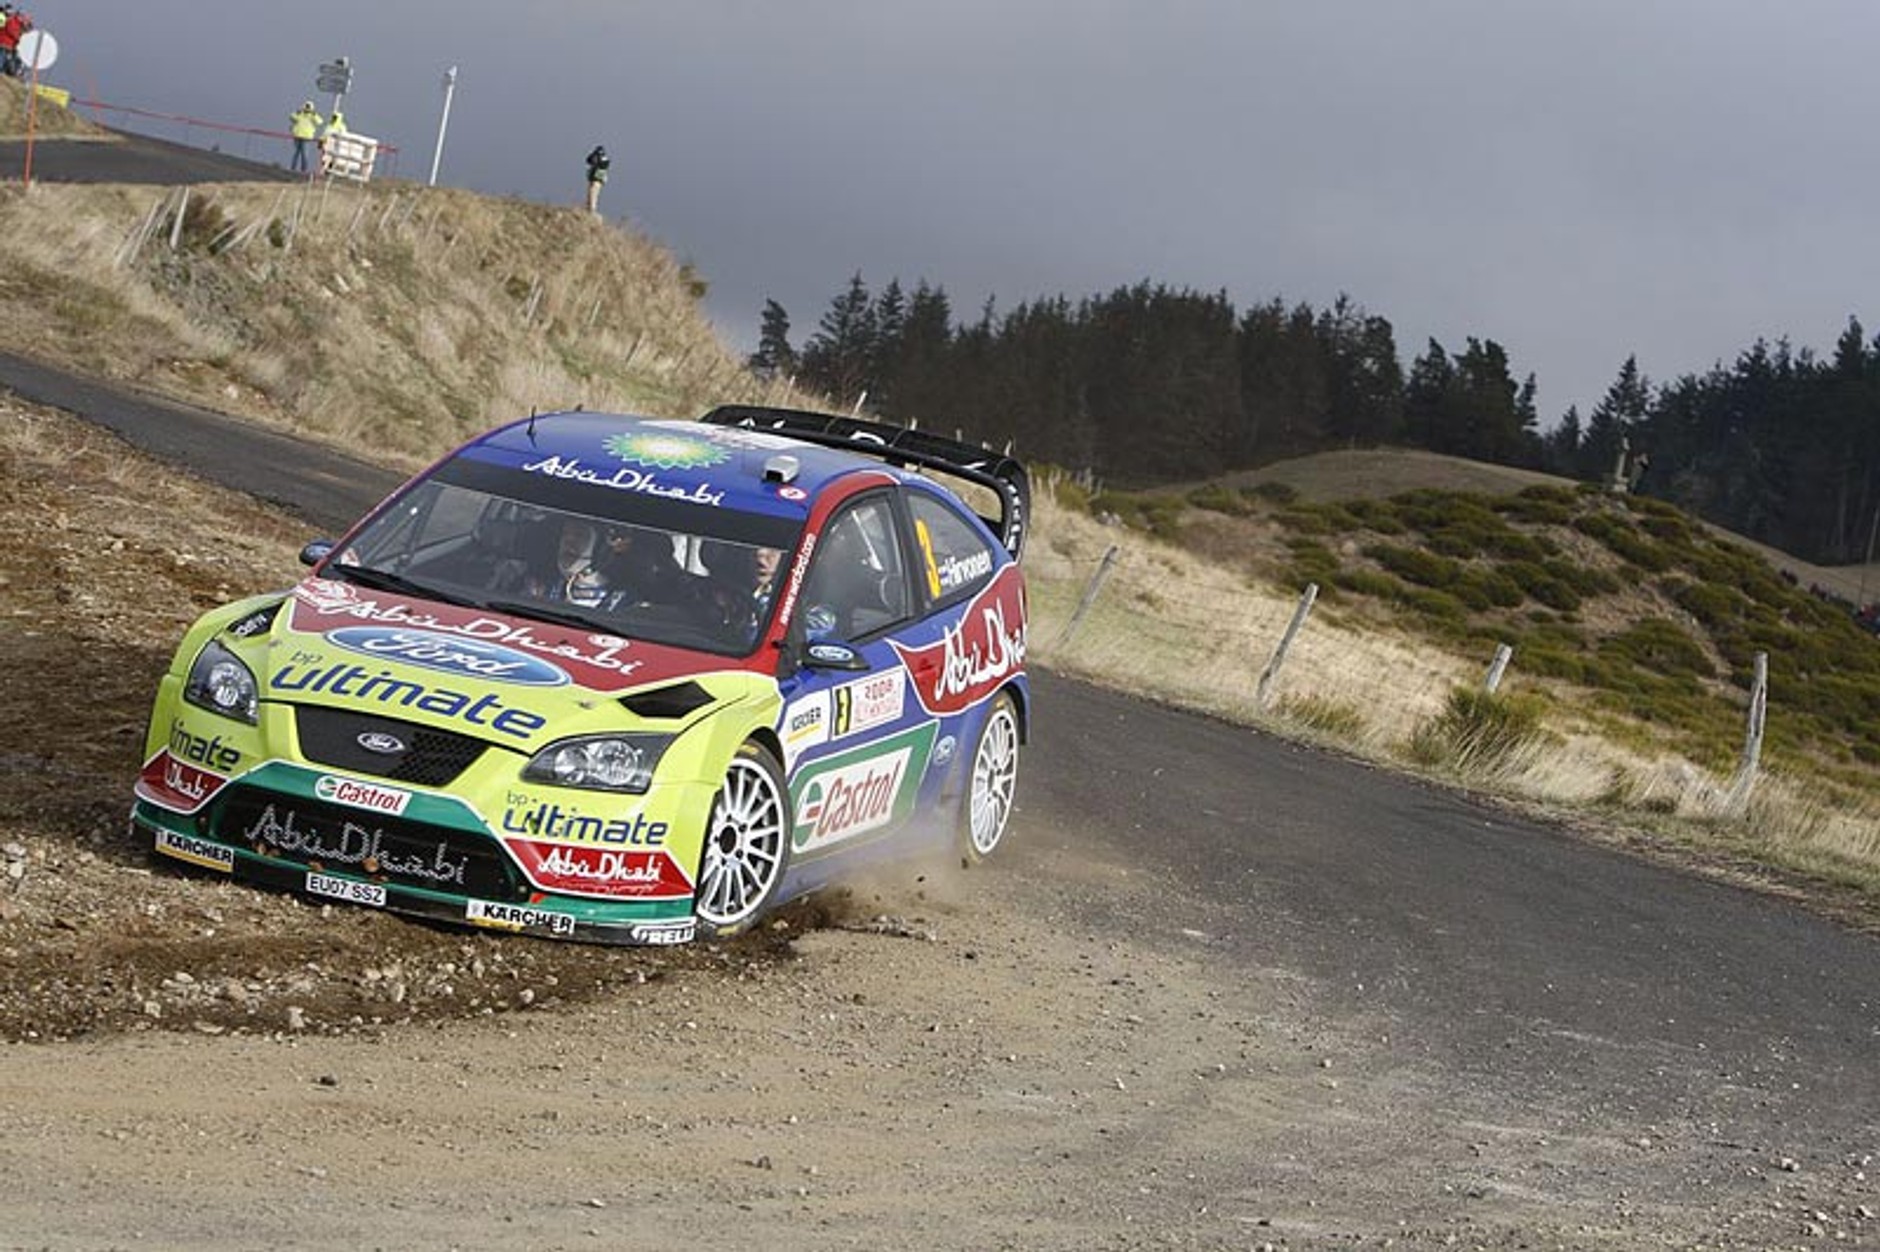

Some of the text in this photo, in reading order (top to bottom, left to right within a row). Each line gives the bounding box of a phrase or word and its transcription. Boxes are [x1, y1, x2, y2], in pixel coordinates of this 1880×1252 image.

[523, 455, 726, 506] Abu Dhabi
[290, 650, 323, 665] bp
[319, 600, 446, 628] Abu
[455, 617, 643, 676] Dhabi
[362, 632, 527, 677] Ford
[270, 664, 546, 739] ultimate
[336, 782, 403, 812] Castrol
[507, 790, 527, 805] bp
[816, 758, 901, 838] Castrol
[245, 803, 469, 885] Abu Dhabi
[503, 803, 668, 845] ultimate
[538, 848, 662, 882] Abu Dhabi
[309, 876, 384, 904] EU07 SSZ
